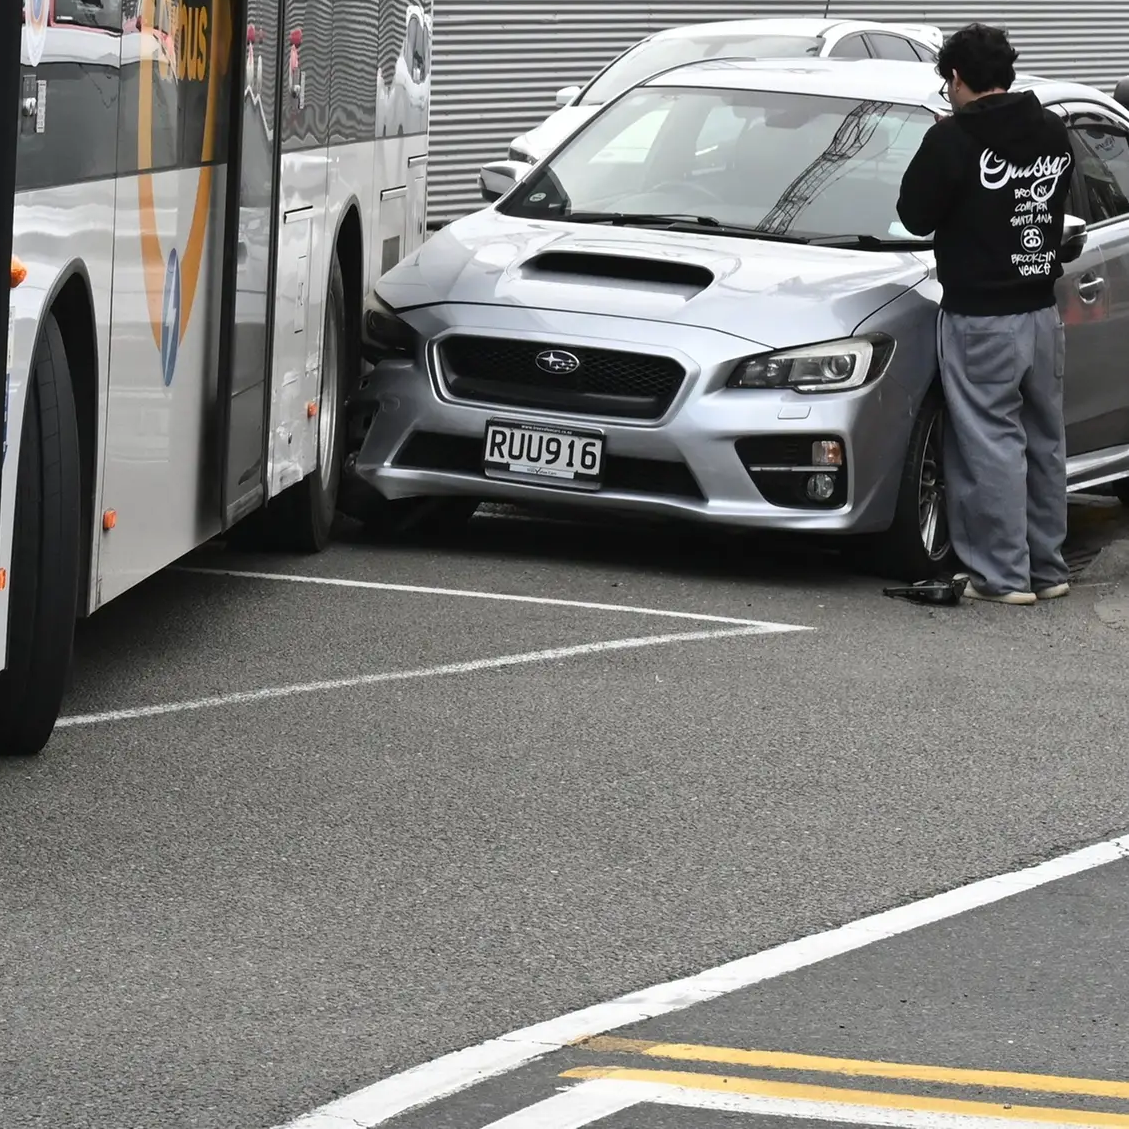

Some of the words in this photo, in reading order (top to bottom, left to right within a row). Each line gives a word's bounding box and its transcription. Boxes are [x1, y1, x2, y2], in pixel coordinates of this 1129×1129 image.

[1014, 201, 1049, 213] COMPTON
[1011, 250, 1057, 265] BROOKLYN
[488, 428, 598, 470] RUU916
